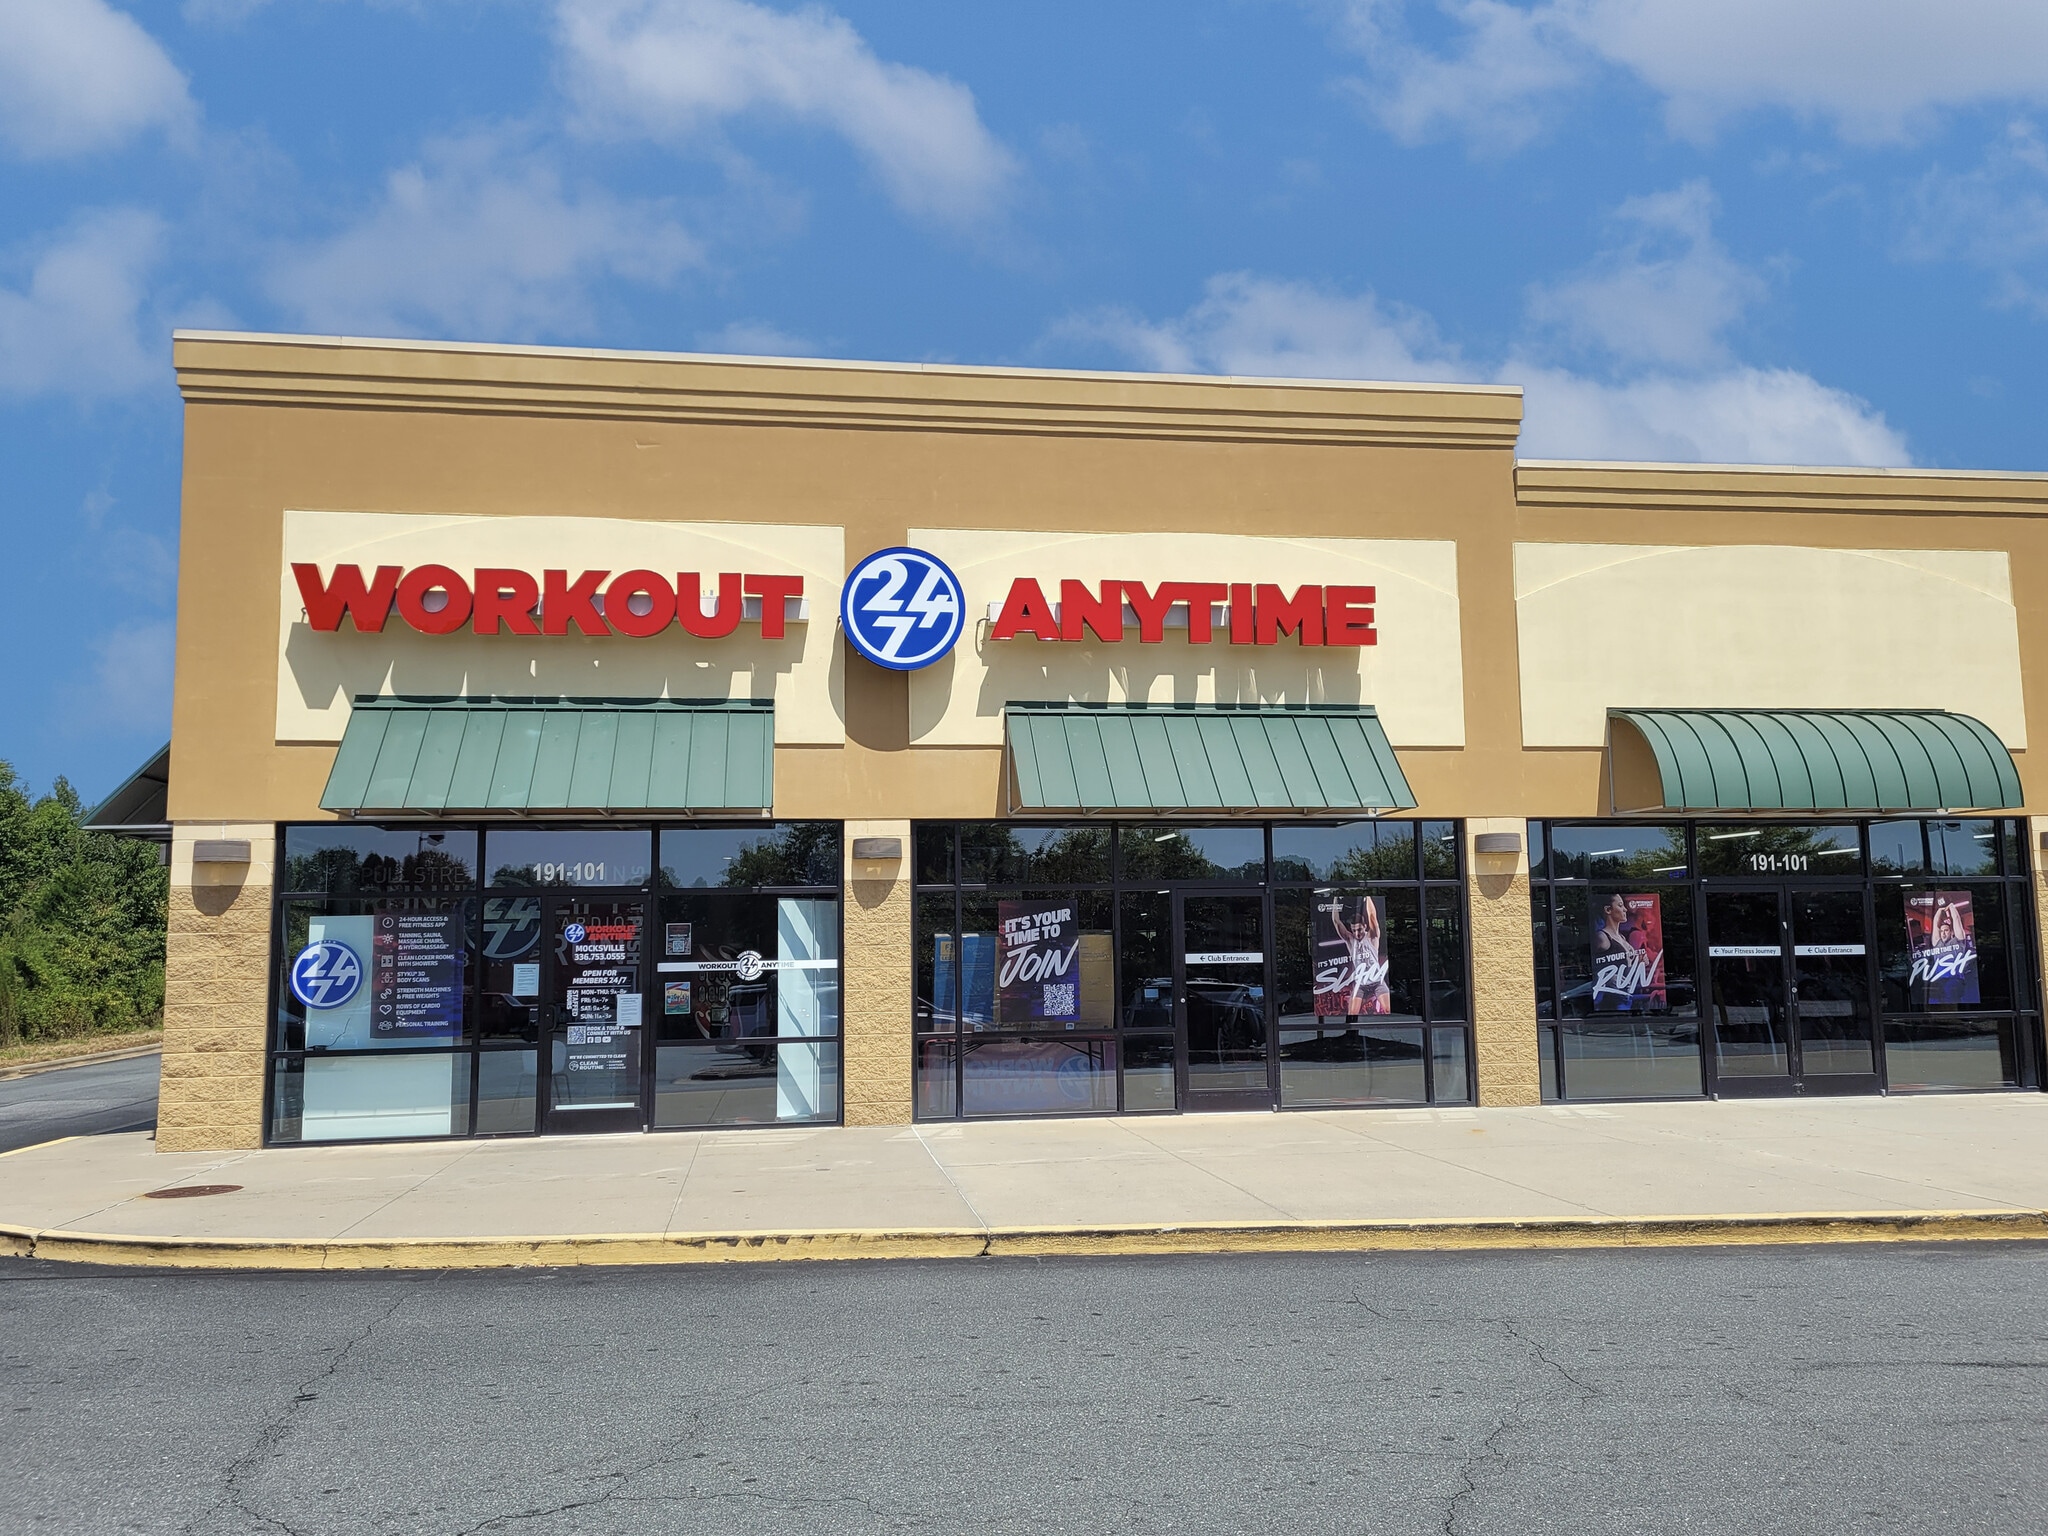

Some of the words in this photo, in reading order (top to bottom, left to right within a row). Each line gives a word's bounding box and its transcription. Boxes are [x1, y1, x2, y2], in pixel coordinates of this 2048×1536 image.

[291, 563, 804, 639] WORKOUT
[990, 577, 1377, 646] ANYTIME
[532, 862, 605, 881] 191-101
[1750, 854, 1808, 871] 191-101
[585, 925, 637, 933] WORKOUT
[1005, 916, 1031, 933] IT'S
[1032, 908, 1071, 927] YOUR
[1005, 927, 1040, 947] TIME
[1041, 924, 1060, 939] TO
[575, 944, 624, 952] MOCKSVILLE
[1596, 956, 1606, 964] IT'S
[1606, 952, 1625, 962] YOUR
[1755, 947, 1776, 955] Journey
[1912, 951, 1921, 959] IT'S
[1922, 947, 1940, 957] YOUR
[999, 938, 1080, 988] JOIN
[1328, 956, 1348, 967] YOUR
[1909, 949, 1977, 987] PUSH
[1313, 959, 1389, 1000] SLAM
[1592, 948, 1664, 1000] RUN
